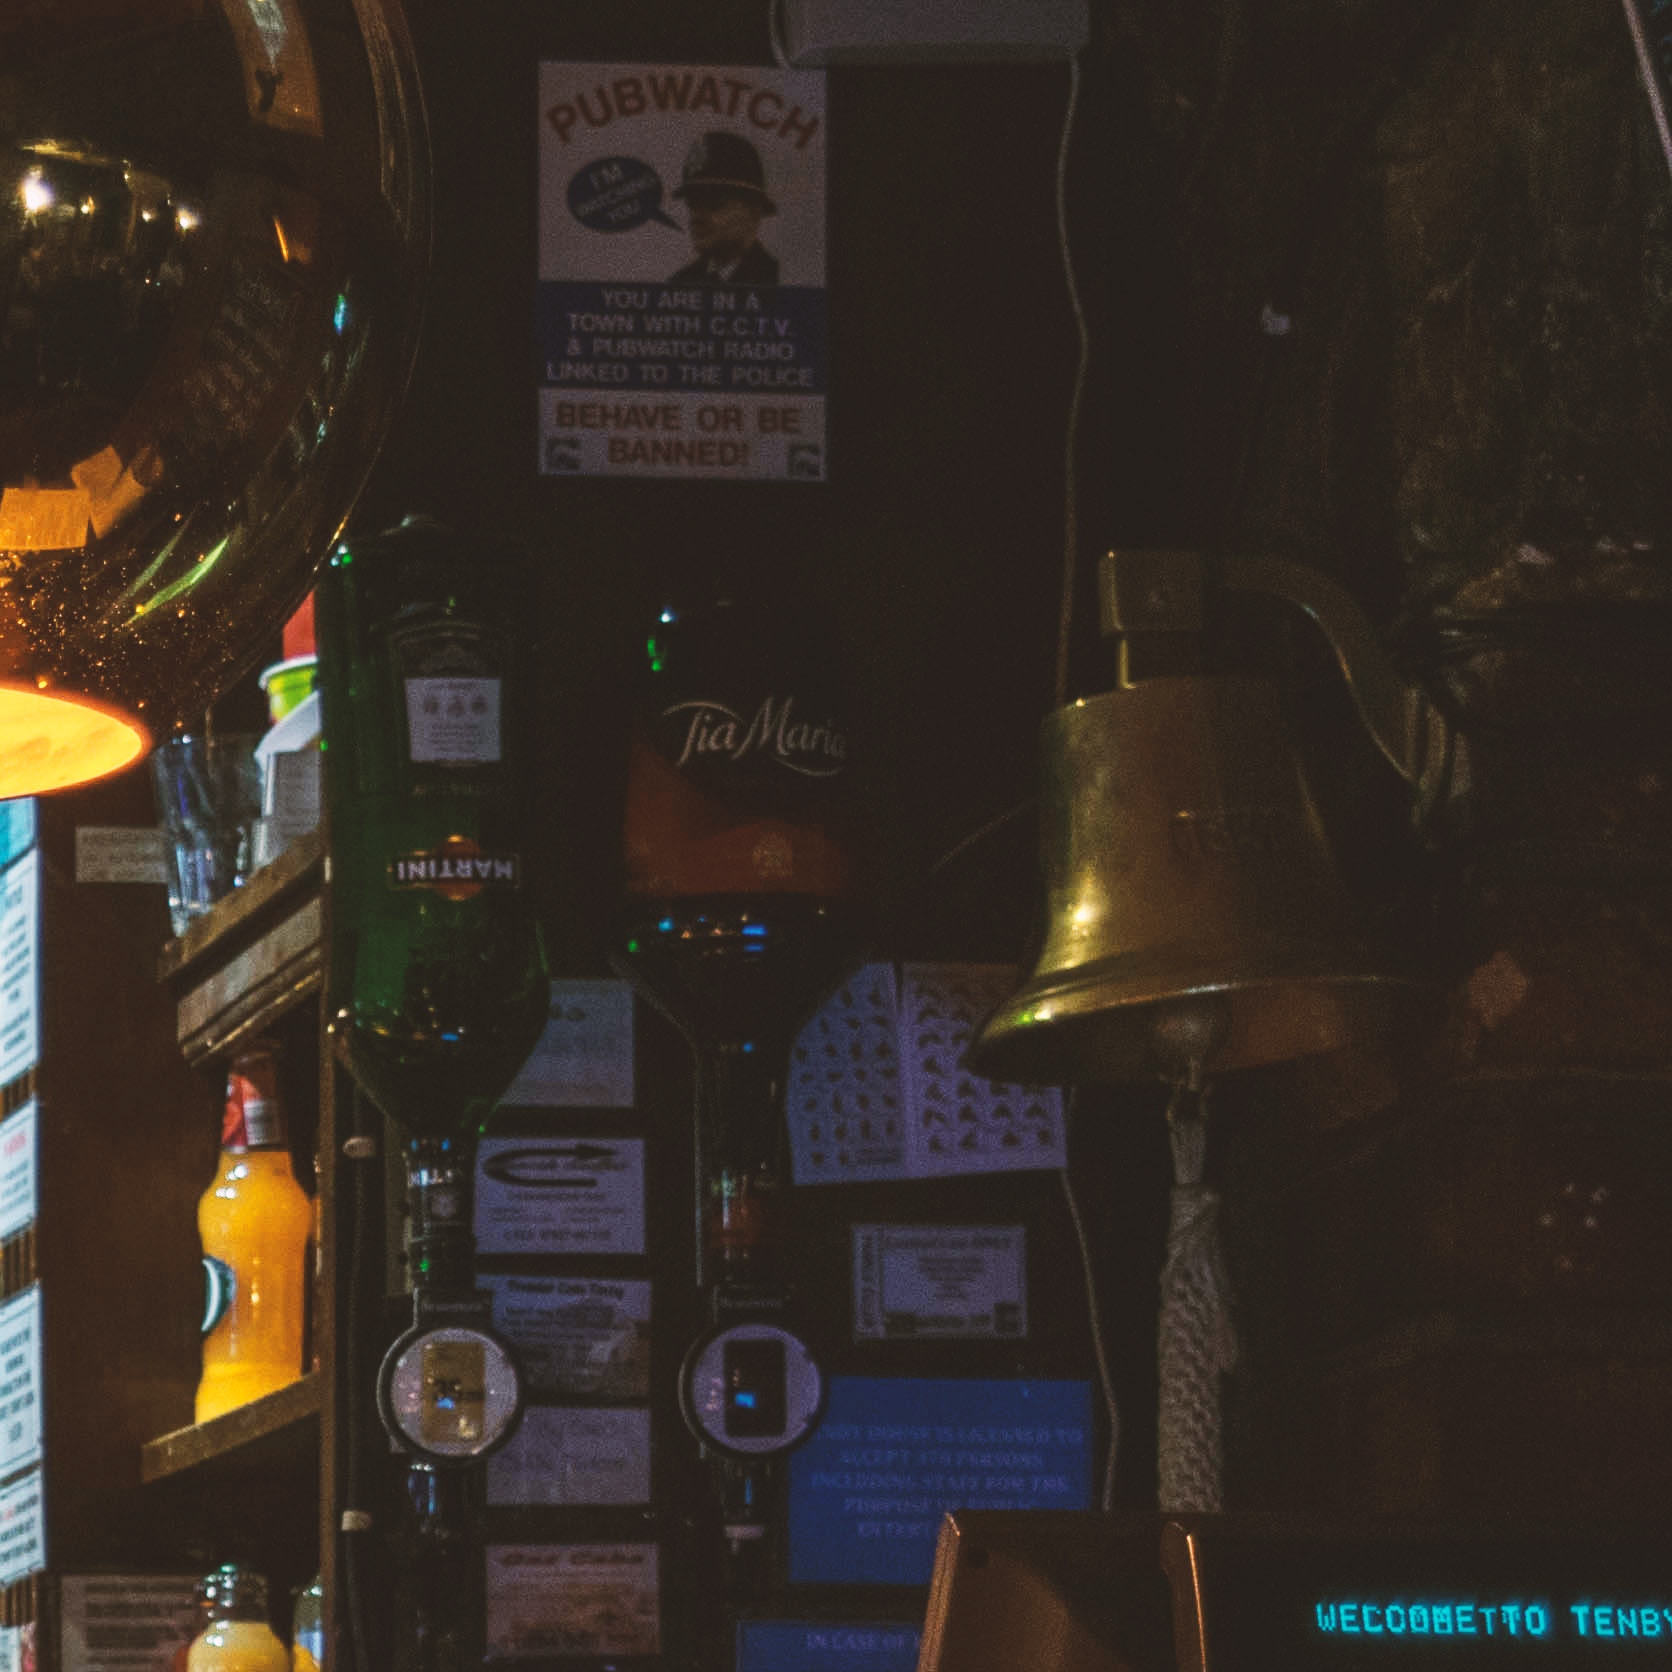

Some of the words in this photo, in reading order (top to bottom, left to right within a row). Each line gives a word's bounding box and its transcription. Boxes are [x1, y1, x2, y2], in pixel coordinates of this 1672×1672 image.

[546, 74, 820, 149] PUBWATCH
[601, 289, 649, 310] YOU
[657, 289, 703, 311] ARE
[712, 291, 738, 312] IN
[745, 292, 760, 312] A
[567, 312, 634, 334] TOWN
[644, 314, 701, 335] WITH
[566, 338, 581, 357] &
[593, 338, 714, 359] PUBWATCH
[724, 340, 795, 361] RADIO
[547, 361, 629, 384] LINKED
[639, 363, 668, 384] TO
[678, 364, 722, 386] THE
[732, 365, 814, 388] POLICE
[556, 401, 681, 432] BEHAVE
[697, 404, 743, 434] OR
[758, 407, 801, 434] BE
[608, 437, 751, 467] BANNED!
[662, 699, 747, 767] Tia
[731, 696, 848, 766] Maria
[396, 858, 514, 881] MARTINI
